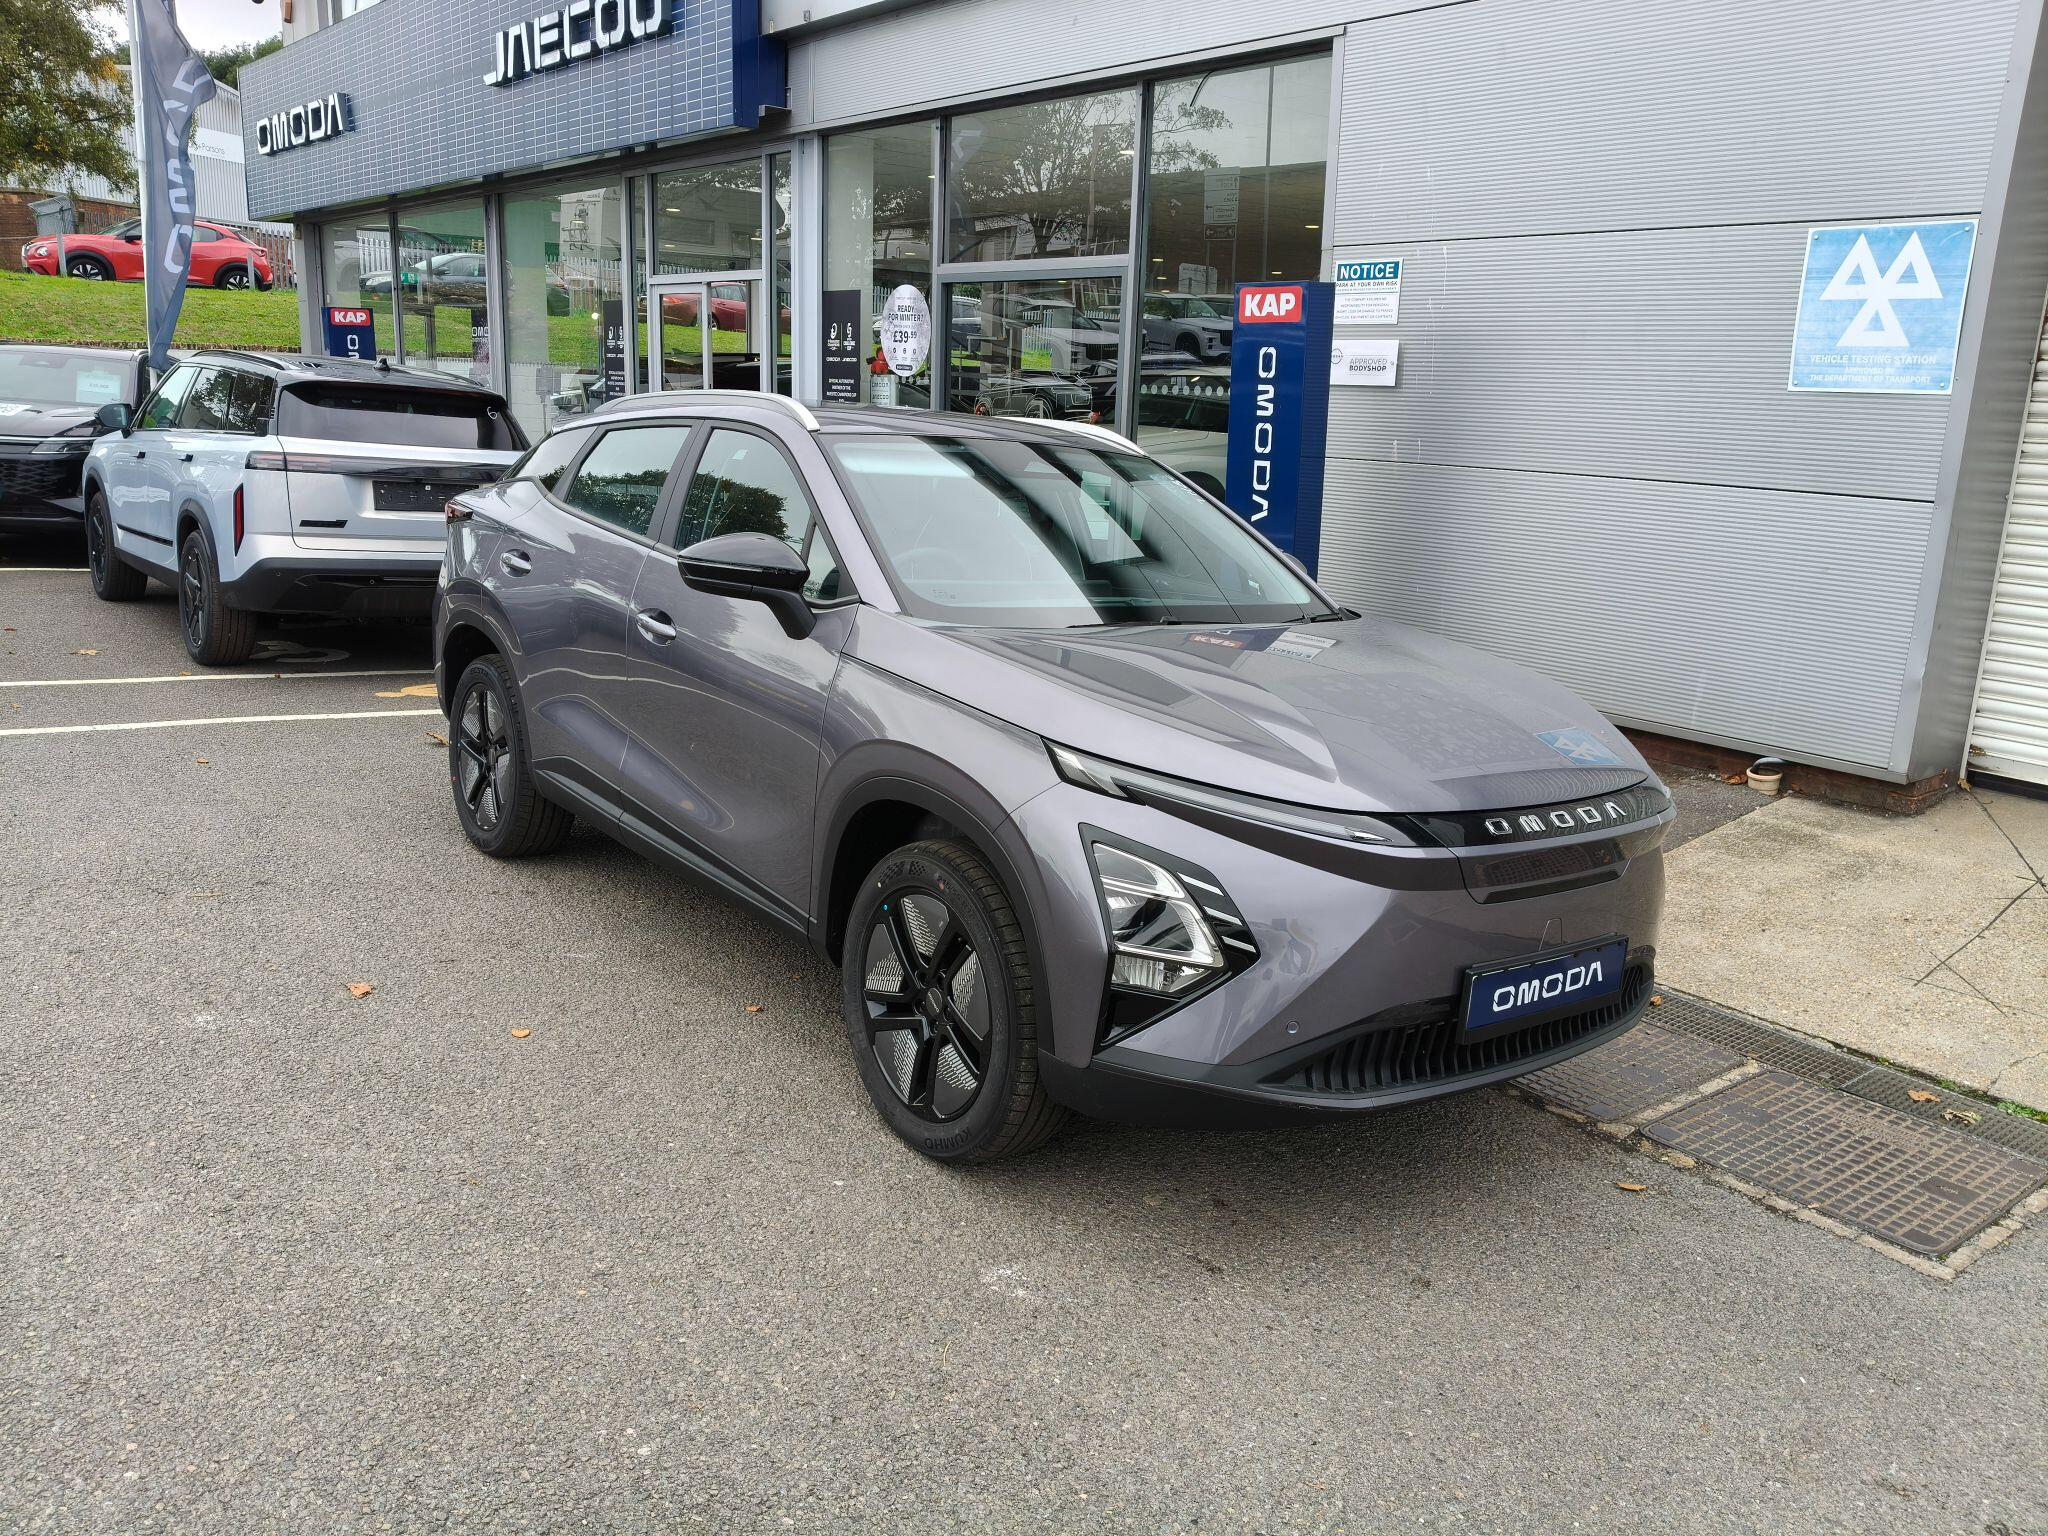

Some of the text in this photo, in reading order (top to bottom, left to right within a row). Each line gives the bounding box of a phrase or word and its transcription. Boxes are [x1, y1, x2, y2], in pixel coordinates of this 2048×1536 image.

[257, 92, 345, 155] OMODA
[1340, 263, 1395, 280] NOTICE
[897, 305, 915, 313] READY
[1244, 292, 1296, 317] KAP
[334, 311, 367, 323] KAP
[899, 313, 924, 322] WINTER?
[1810, 354, 1937, 365] VEHICLE TESTING STATION
[1809, 374, 1823, 382] THE
[1824, 374, 1872, 383] DEPARTMENT
[1885, 375, 1931, 384] TRANSPORT
[1250, 346, 1277, 522] OMODA
[1484, 801, 1628, 836] OMODA
[1491, 960, 1604, 1013] OMODA
